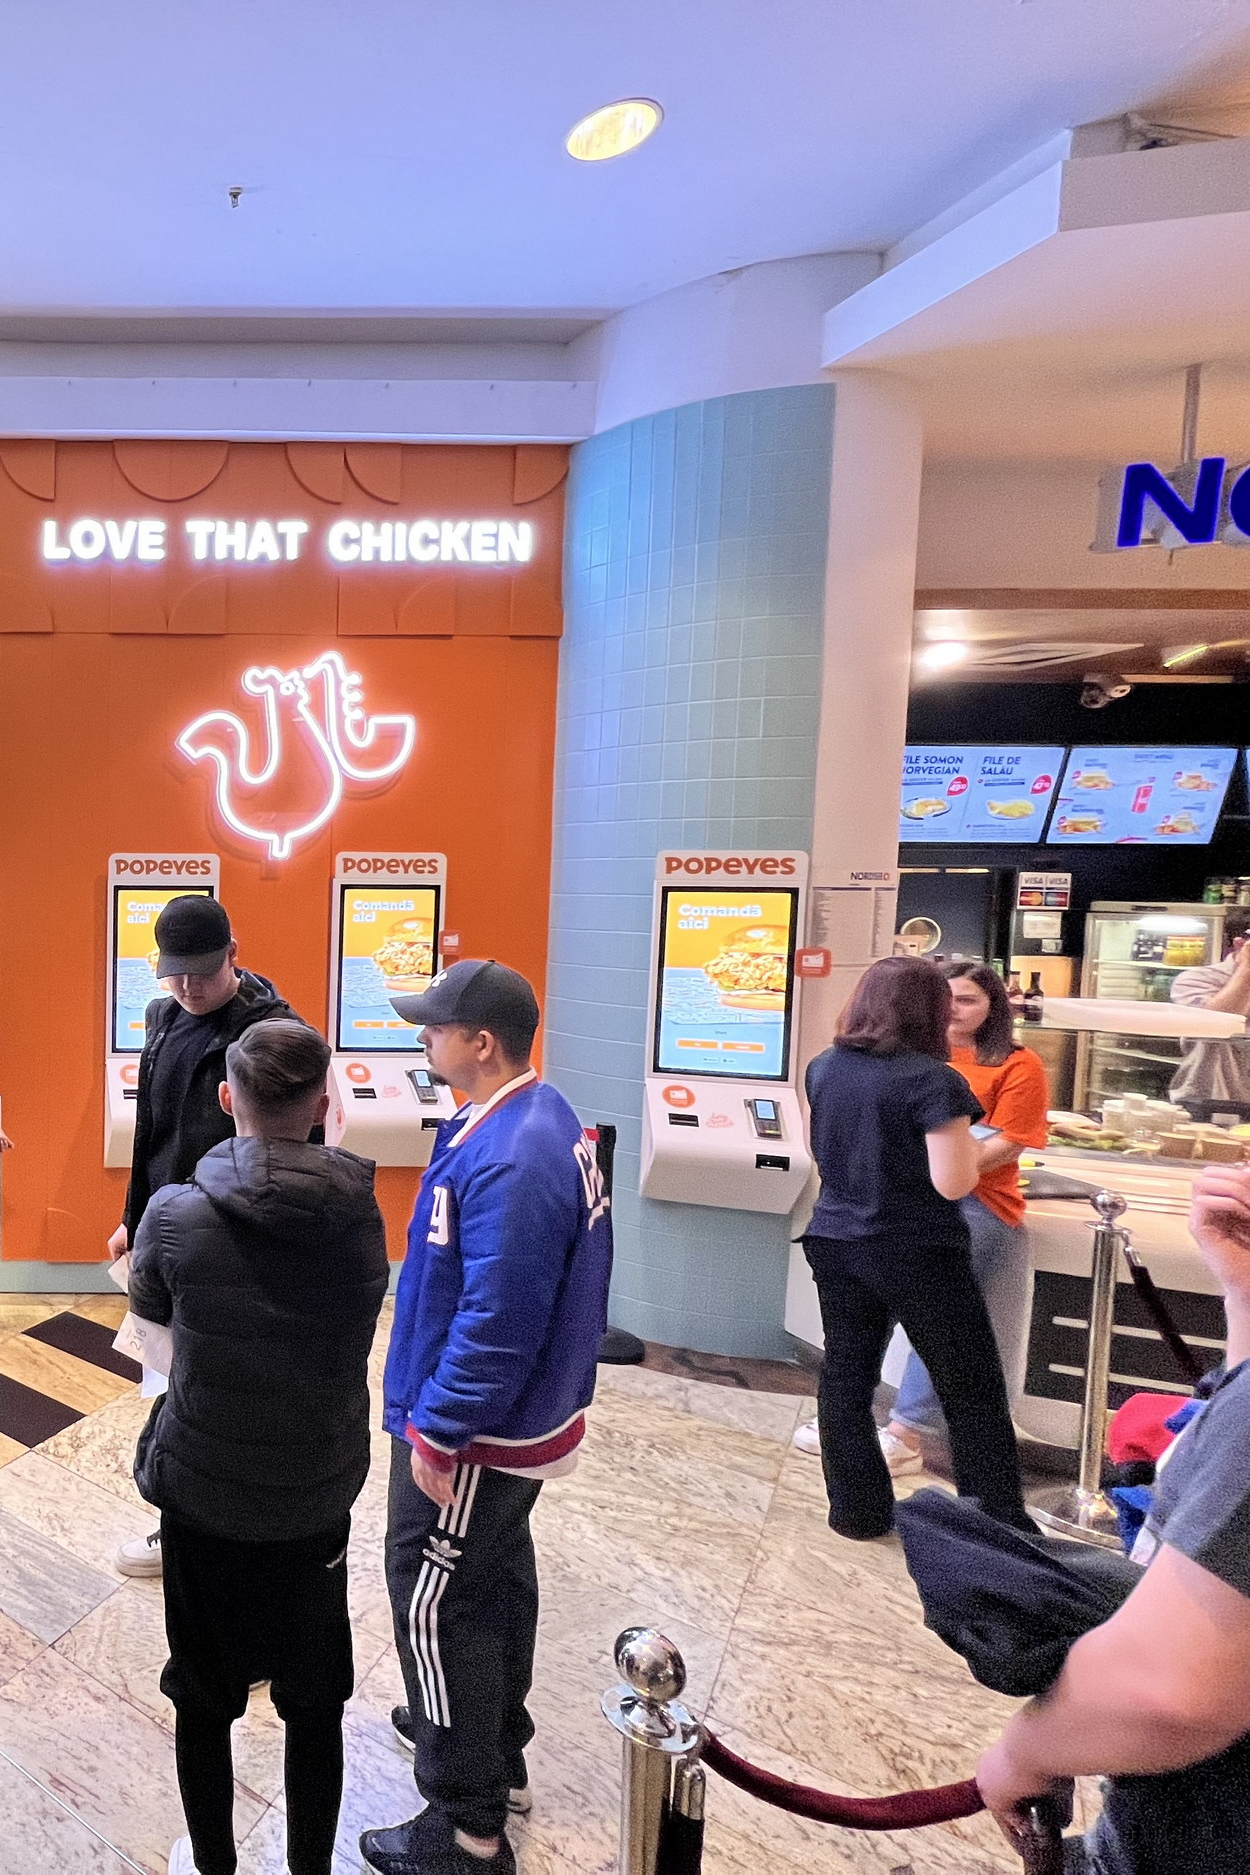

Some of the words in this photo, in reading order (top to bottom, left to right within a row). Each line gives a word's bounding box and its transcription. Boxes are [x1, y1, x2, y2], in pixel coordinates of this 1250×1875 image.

[1116, 456, 1250, 547] N
[42, 519, 165, 562] LOVE
[186, 519, 308, 562] THAT
[328, 519, 533, 563] CHICKEN
[923, 755, 964, 765] SOMON
[982, 756, 1005, 765] FILE
[1006, 756, 1022, 765] DE
[127, 912, 150, 923] aici
[353, 911, 376, 923] aici
[677, 916, 709, 930] aici
[130, 1327, 147, 1351] 218
[422, 1548, 456, 1571] adidas
